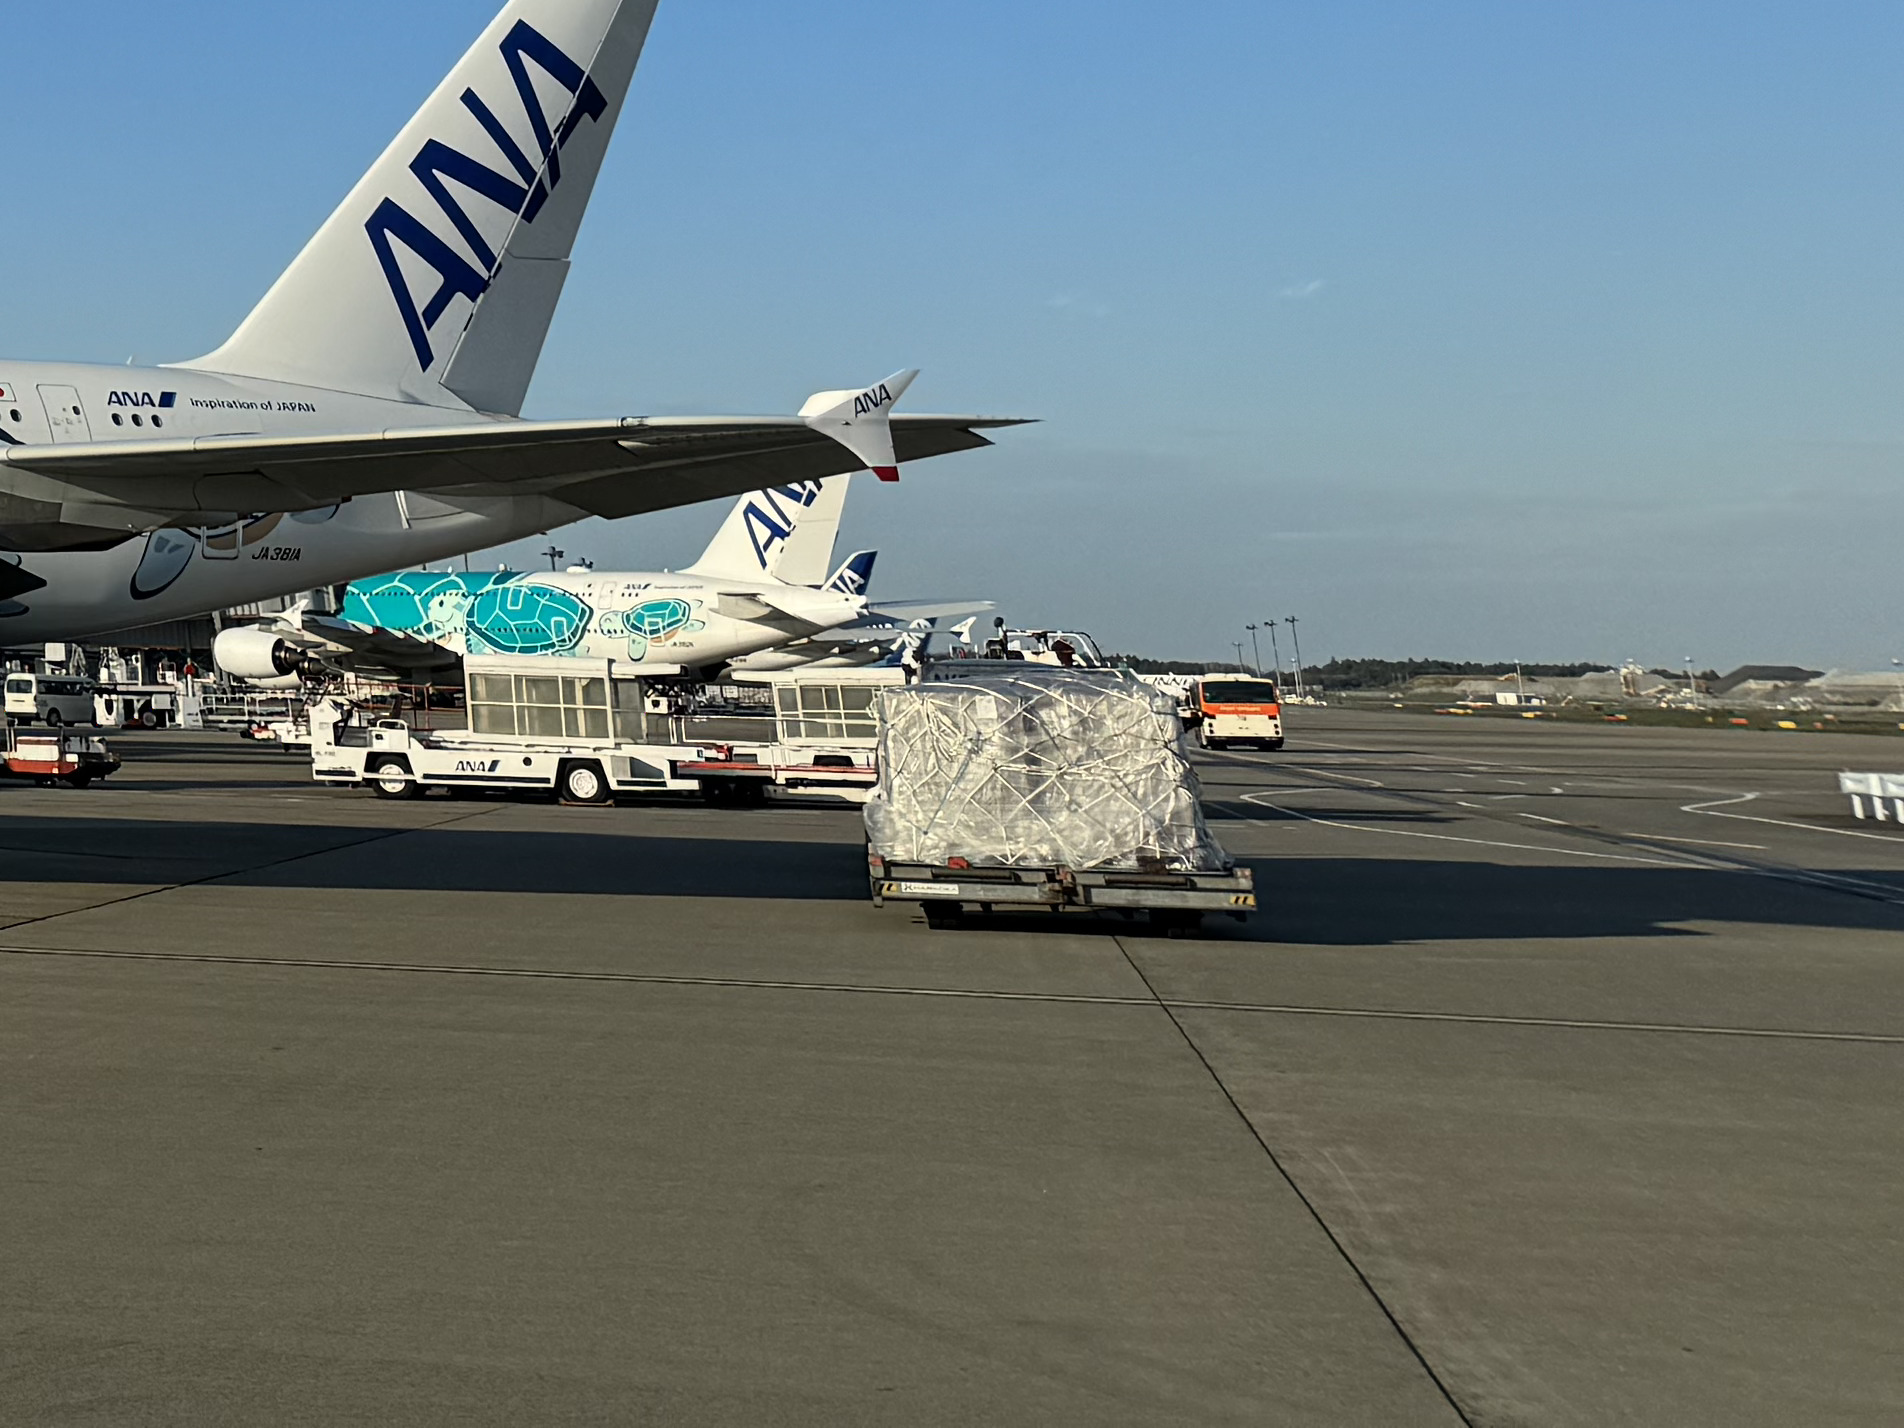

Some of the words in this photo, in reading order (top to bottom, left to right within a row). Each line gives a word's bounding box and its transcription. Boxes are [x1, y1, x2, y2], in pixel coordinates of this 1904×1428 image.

[364, 18, 609, 373] ANA
[107, 390, 156, 408] ANA
[190, 397, 258, 410] Inspiration
[260, 400, 273, 410] of
[277, 402, 316, 413] JAPAN
[854, 383, 892, 418] ANA
[743, 478, 823, 570] AN
[455, 760, 486, 772] ANA
